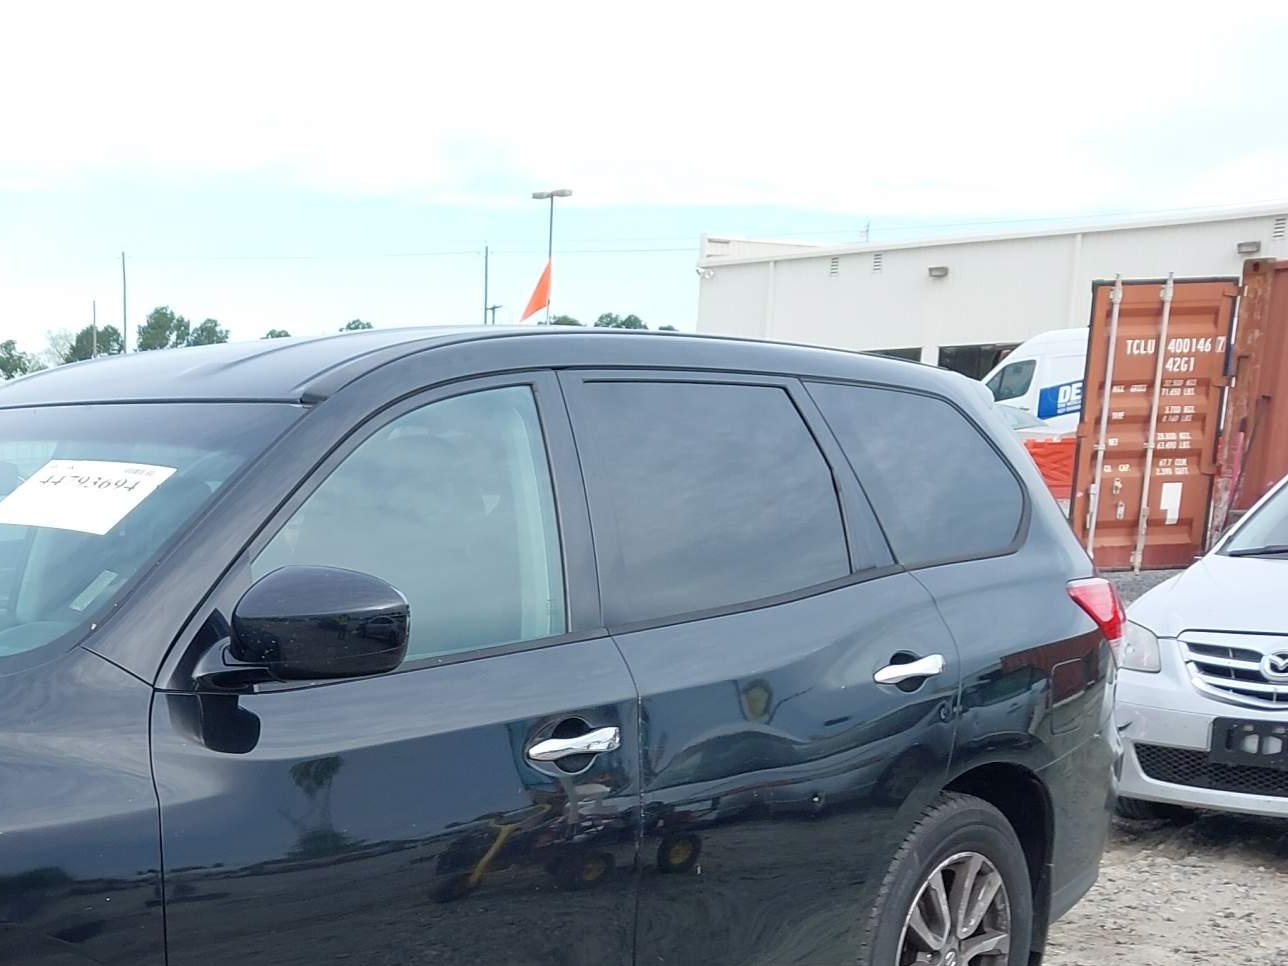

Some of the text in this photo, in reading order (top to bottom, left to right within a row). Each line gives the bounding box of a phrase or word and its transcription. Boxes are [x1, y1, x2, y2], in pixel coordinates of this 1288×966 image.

[1126, 336, 1226, 355] TCLU 400146 7
[1165, 357, 1195, 372] 42G1
